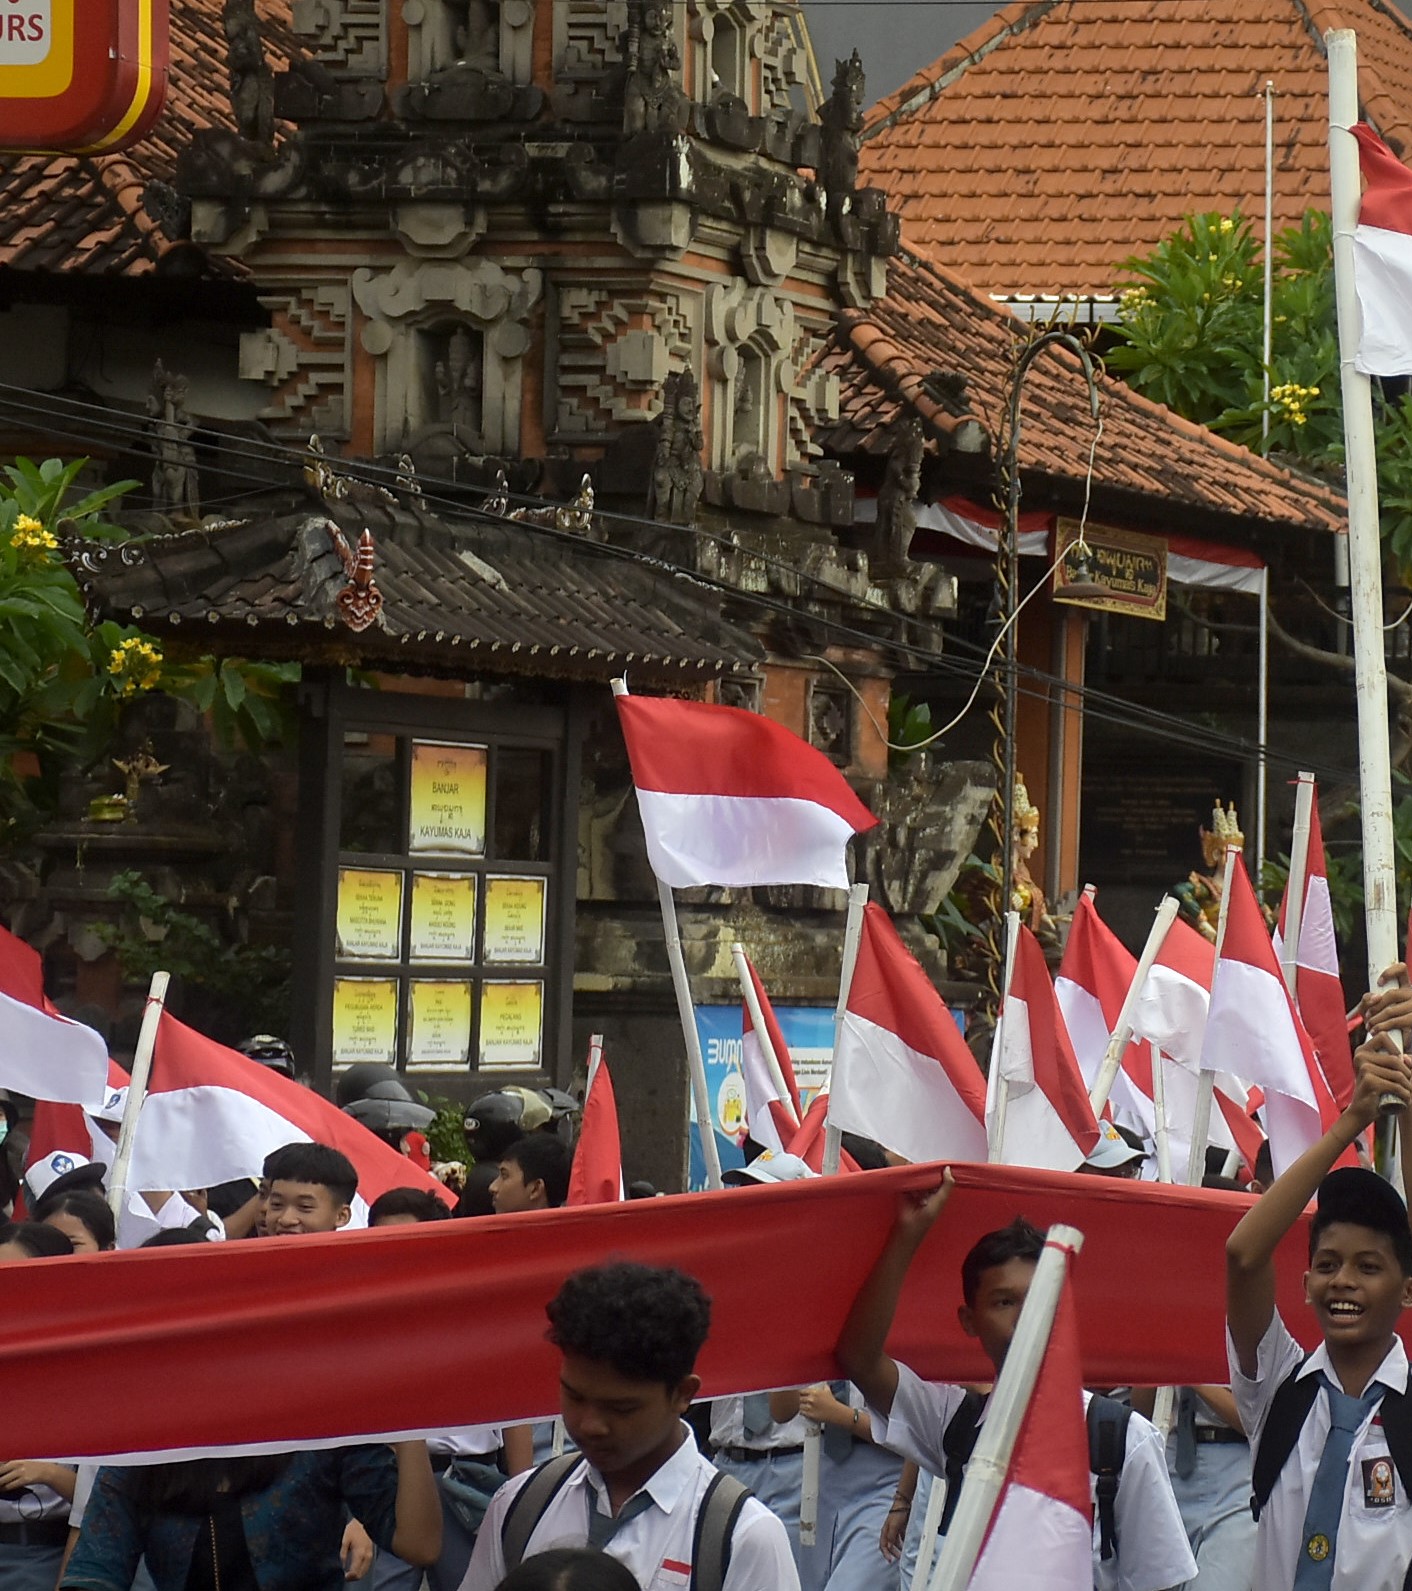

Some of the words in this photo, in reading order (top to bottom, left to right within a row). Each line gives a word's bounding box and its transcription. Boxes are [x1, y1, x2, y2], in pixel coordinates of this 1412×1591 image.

[432, 782, 459, 795] BANJAR
[420, 825, 452, 838] KAYUMAS
[454, 828, 472, 839] KAJA
